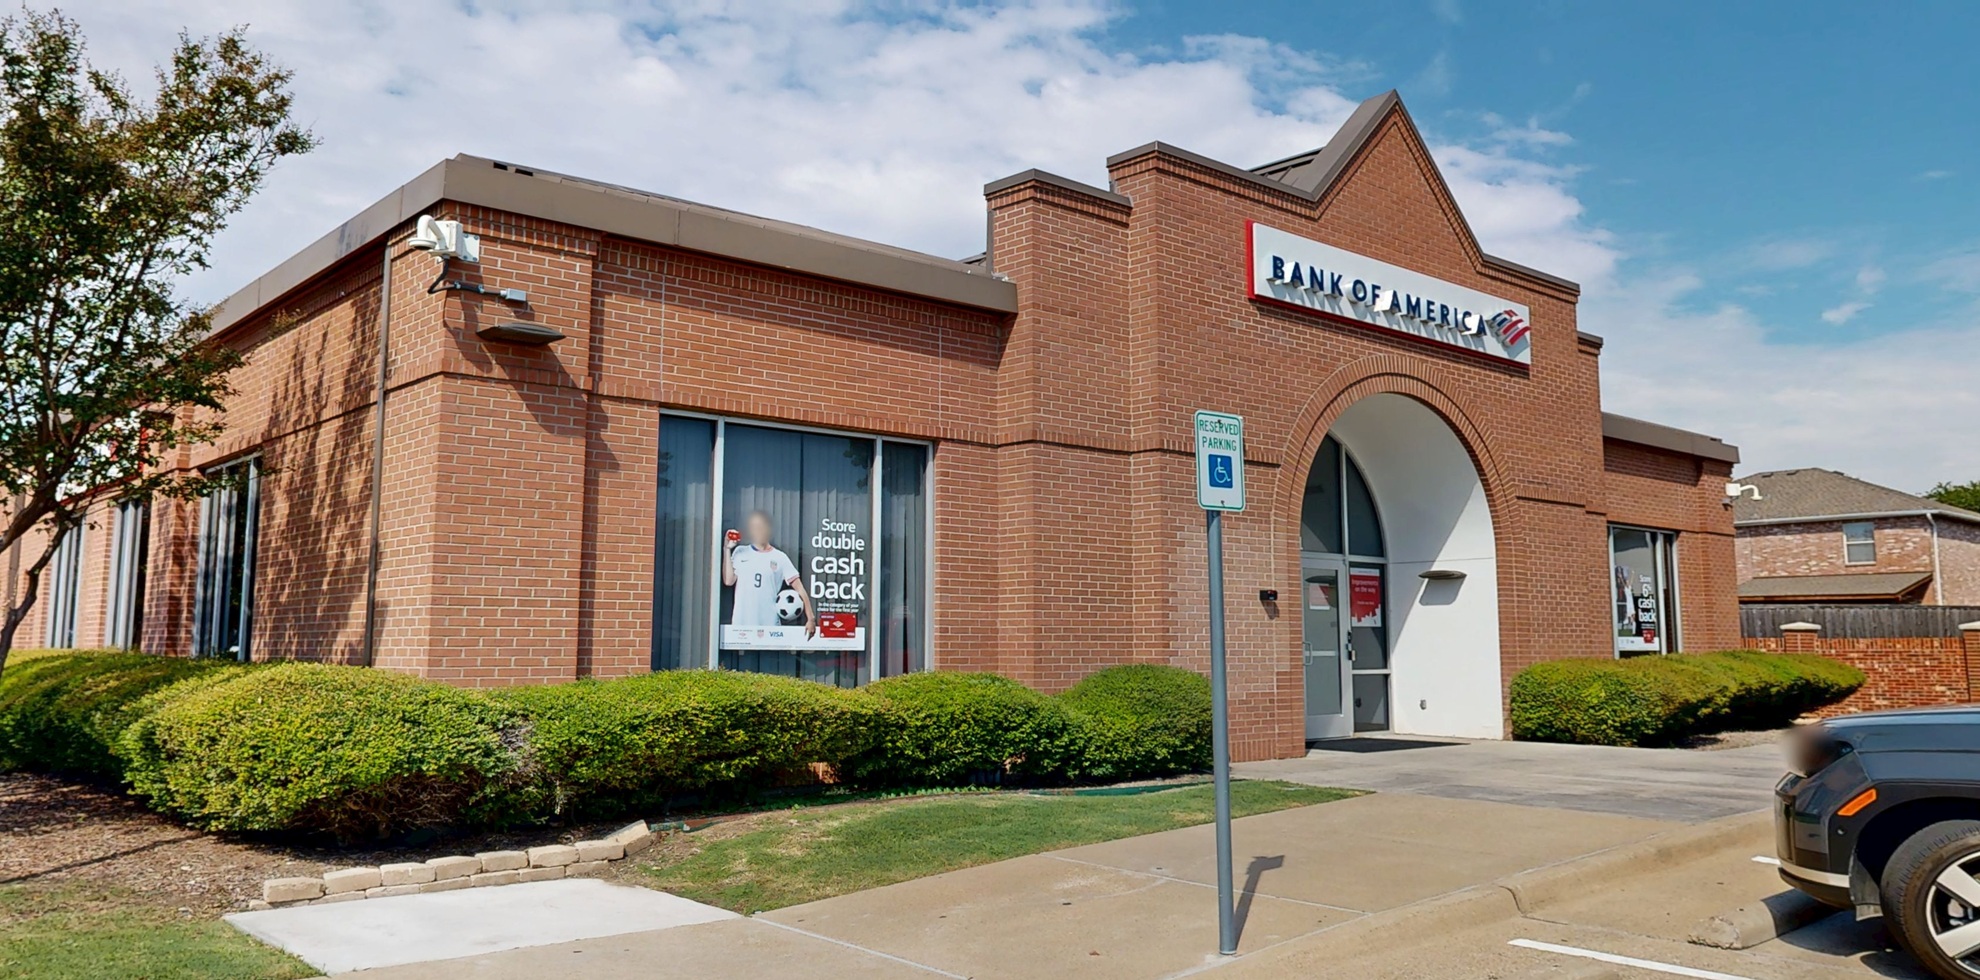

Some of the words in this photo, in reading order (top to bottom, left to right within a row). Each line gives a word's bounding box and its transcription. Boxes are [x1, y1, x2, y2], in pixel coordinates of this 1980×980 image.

[1271, 254, 1344, 298] BANK
[1351, 279, 1382, 306] OF
[1390, 289, 1488, 336] AMERICA
[1198, 419, 1239, 436] RESERVED
[1202, 436, 1237, 452] PARKING
[821, 518, 856, 533] Score
[811, 532, 865, 551] double
[811, 551, 864, 575] cash
[754, 572, 762, 588] 9
[810, 574, 865, 600] back
[1638, 595, 1655, 609] cash
[1638, 608, 1656, 623] back
